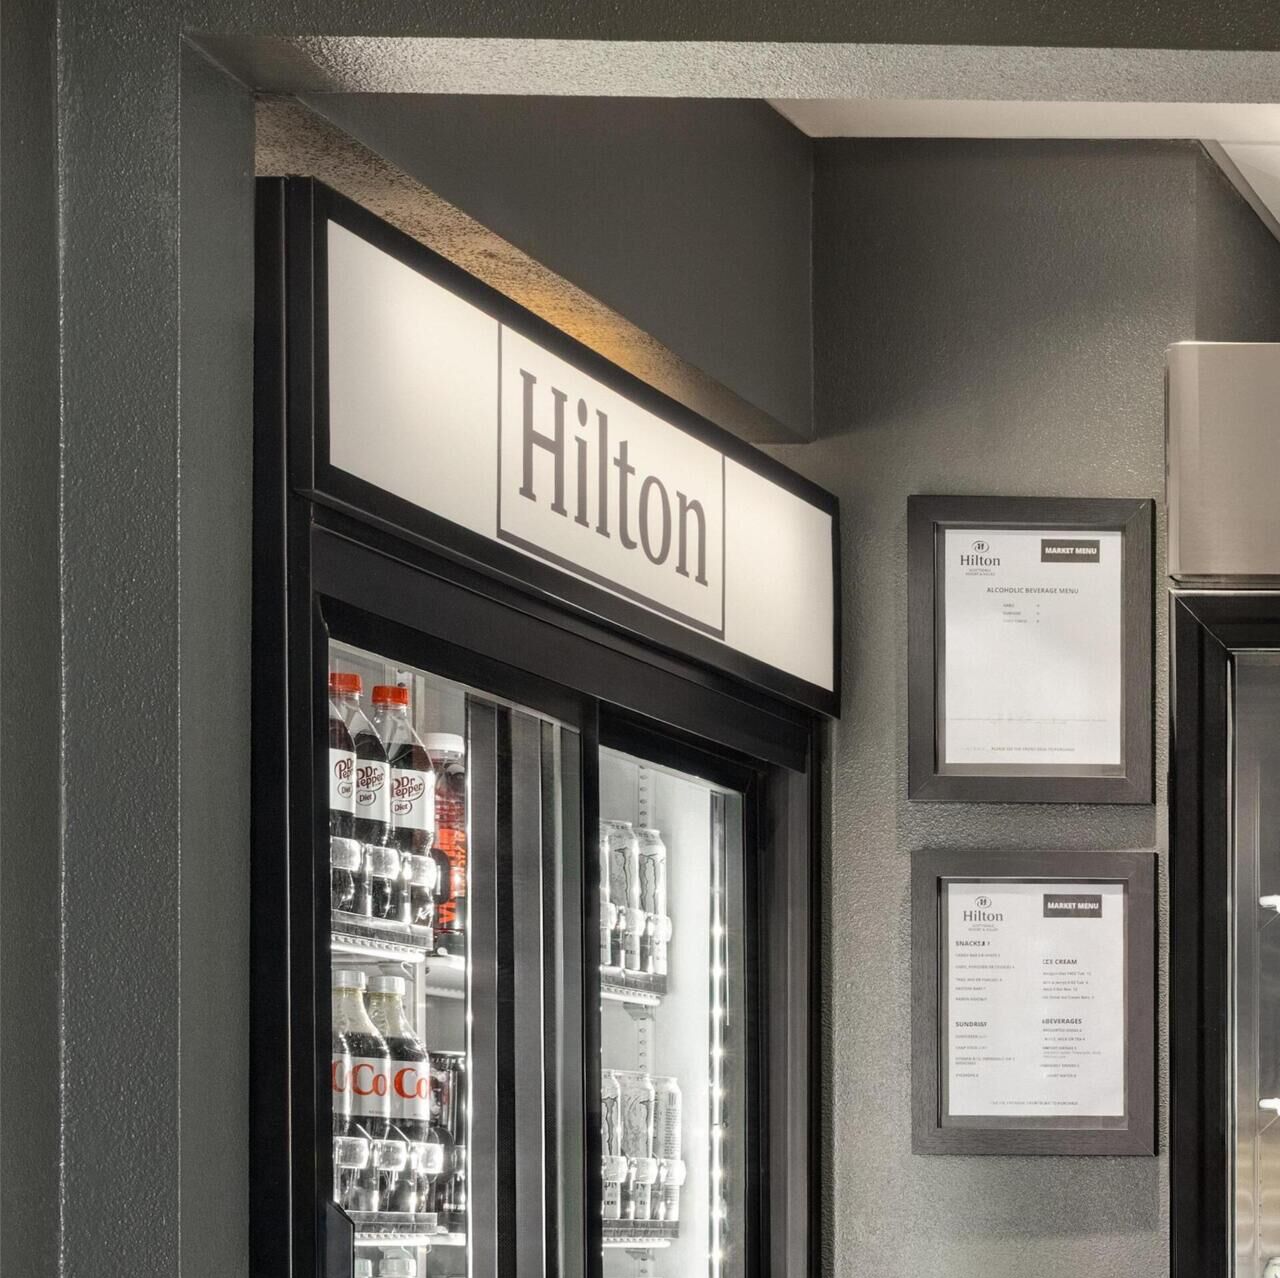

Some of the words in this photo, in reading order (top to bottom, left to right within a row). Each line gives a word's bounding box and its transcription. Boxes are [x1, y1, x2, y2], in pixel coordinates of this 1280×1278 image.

[519, 368, 709, 586] Hilton
[1075, 547, 1097, 555] MENU
[960, 555, 1001, 566] Hilton
[365, 766, 378, 776] Dr
[357, 768, 384, 788] Pepper
[401, 776, 415, 787] Dr
[392, 778, 423, 798] Pepper
[359, 793, 372, 802] Diet
[394, 803, 409, 812] Diet
[1077, 902, 1099, 910] MENU
[963, 910, 1004, 921] Hilton
